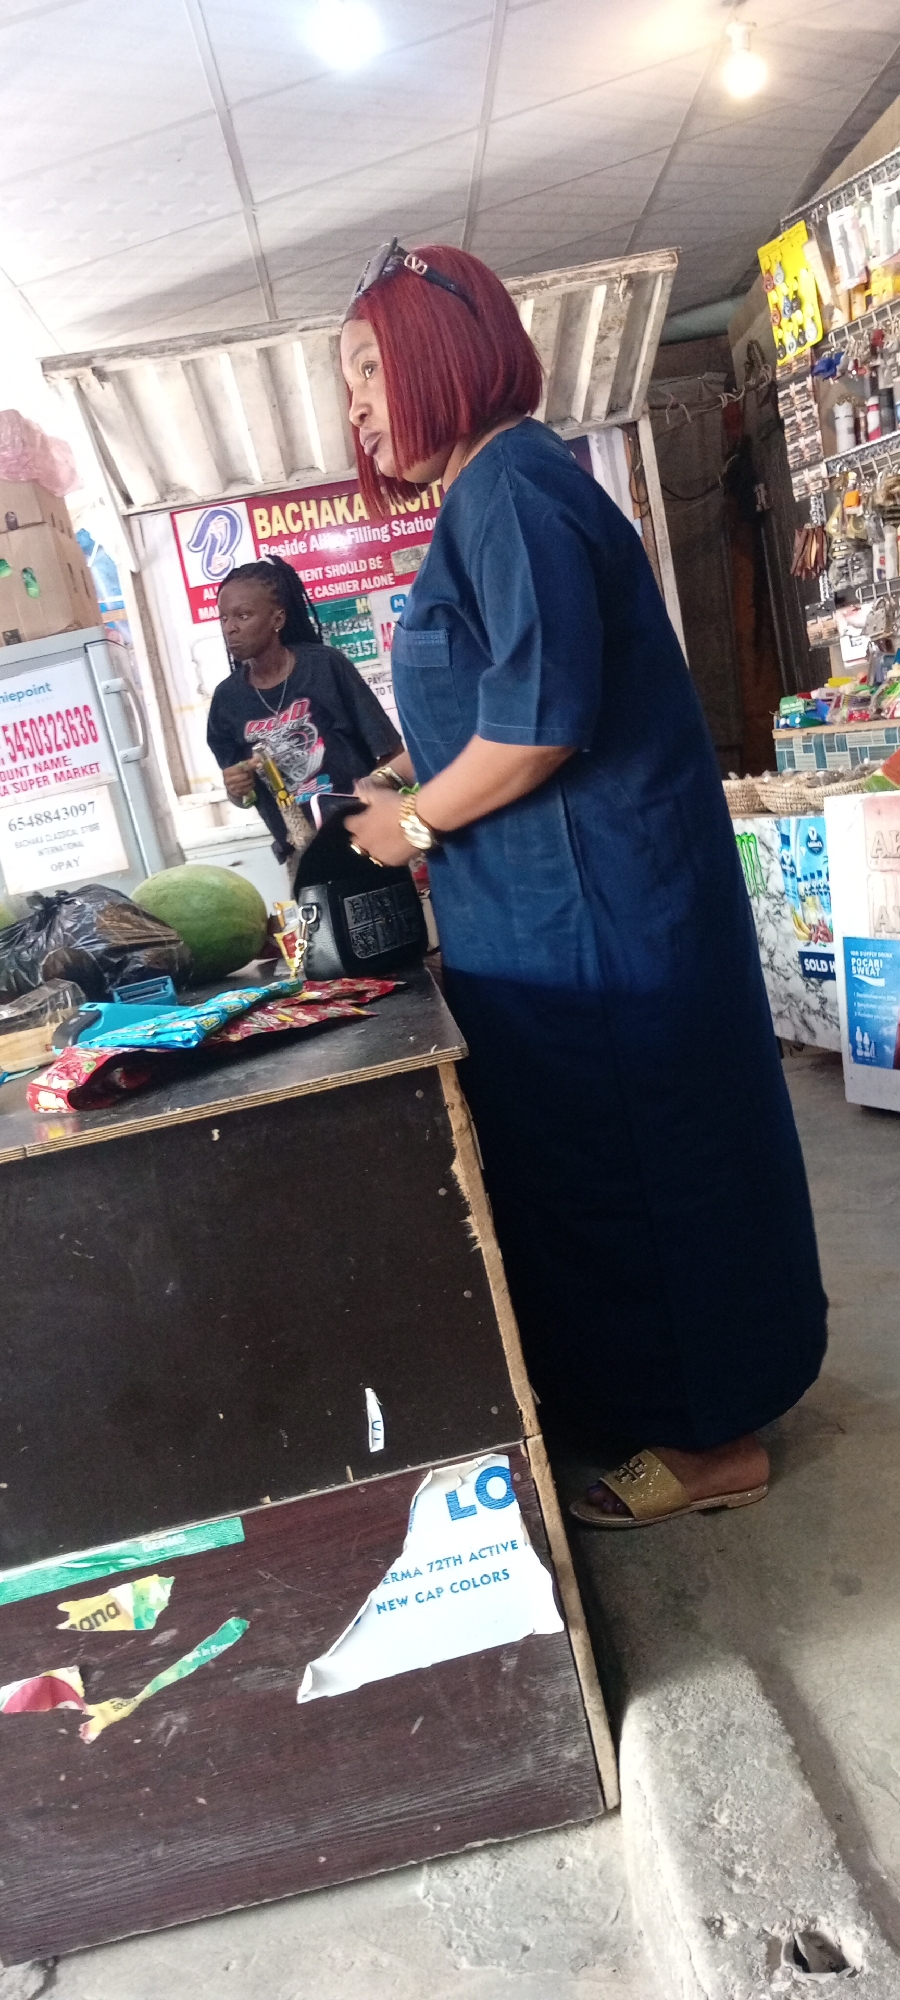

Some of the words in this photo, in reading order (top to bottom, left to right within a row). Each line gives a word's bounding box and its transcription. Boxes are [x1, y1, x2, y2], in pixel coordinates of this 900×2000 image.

[253, 493, 370, 540] BACHAKA
[258, 539, 308, 559] Beside
[346, 524, 390, 546] Filling
[324, 560, 368, 579] SHOULD
[368, 555, 384, 570] BE
[314, 576, 360, 599] CASHIER
[360, 572, 395, 591] ALONE
[1, 704, 99, 763] 5450323636
[12, 775, 51, 794] SUPER
[54, 762, 101, 784] MARKET
[8, 800, 95, 832] 6548843097
[51, 856, 80, 872] OPAY
[804, 958, 829, 973] SOLD
[850, 957, 883, 969] POCARI
[851, 966, 881, 977] SWEAT
[427, 1554, 463, 1574] 72TH
[468, 1539, 519, 1562] ACTIVE
[375, 1595, 409, 1614] NEW
[414, 1586, 444, 1604] CAP
[449, 1568, 510, 1594] COLORS
